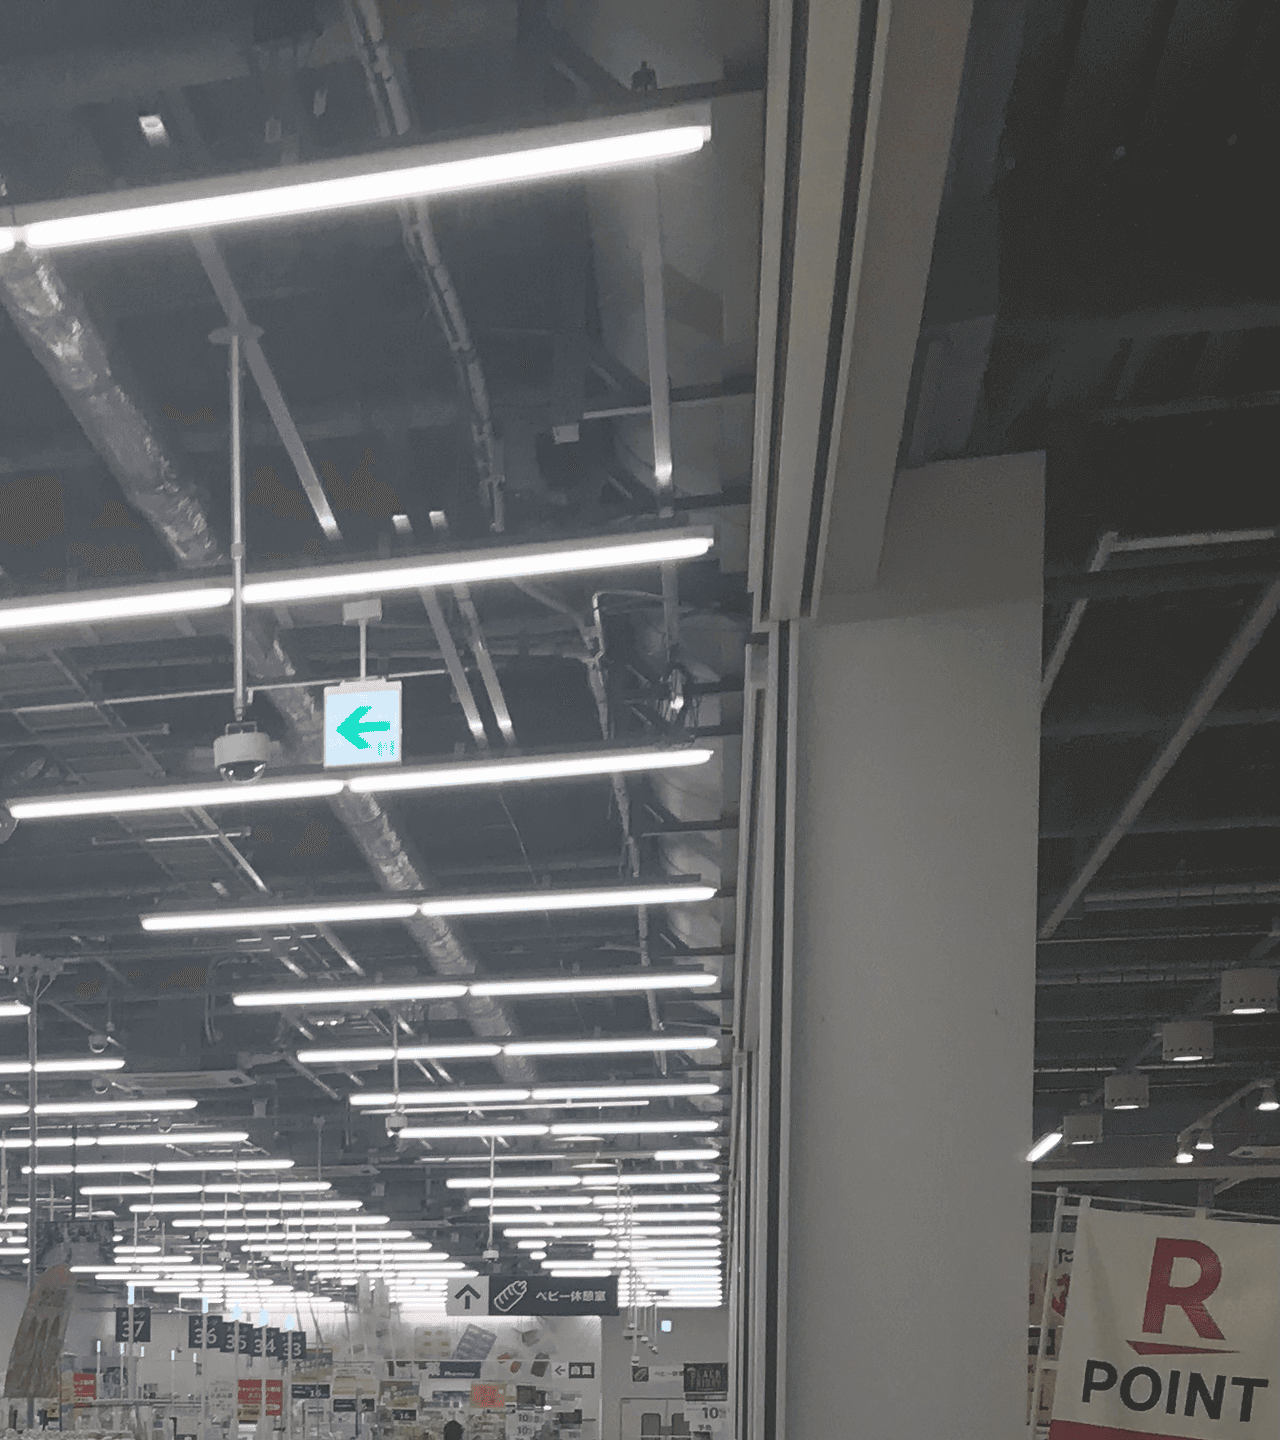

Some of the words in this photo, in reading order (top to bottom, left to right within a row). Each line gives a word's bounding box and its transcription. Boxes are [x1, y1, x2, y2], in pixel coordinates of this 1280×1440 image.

[1142, 1237, 1226, 1340] R
[121, 1320, 146, 1338] 37
[194, 1328, 217, 1345] 36
[1082, 1359, 1269, 1422] POINT
